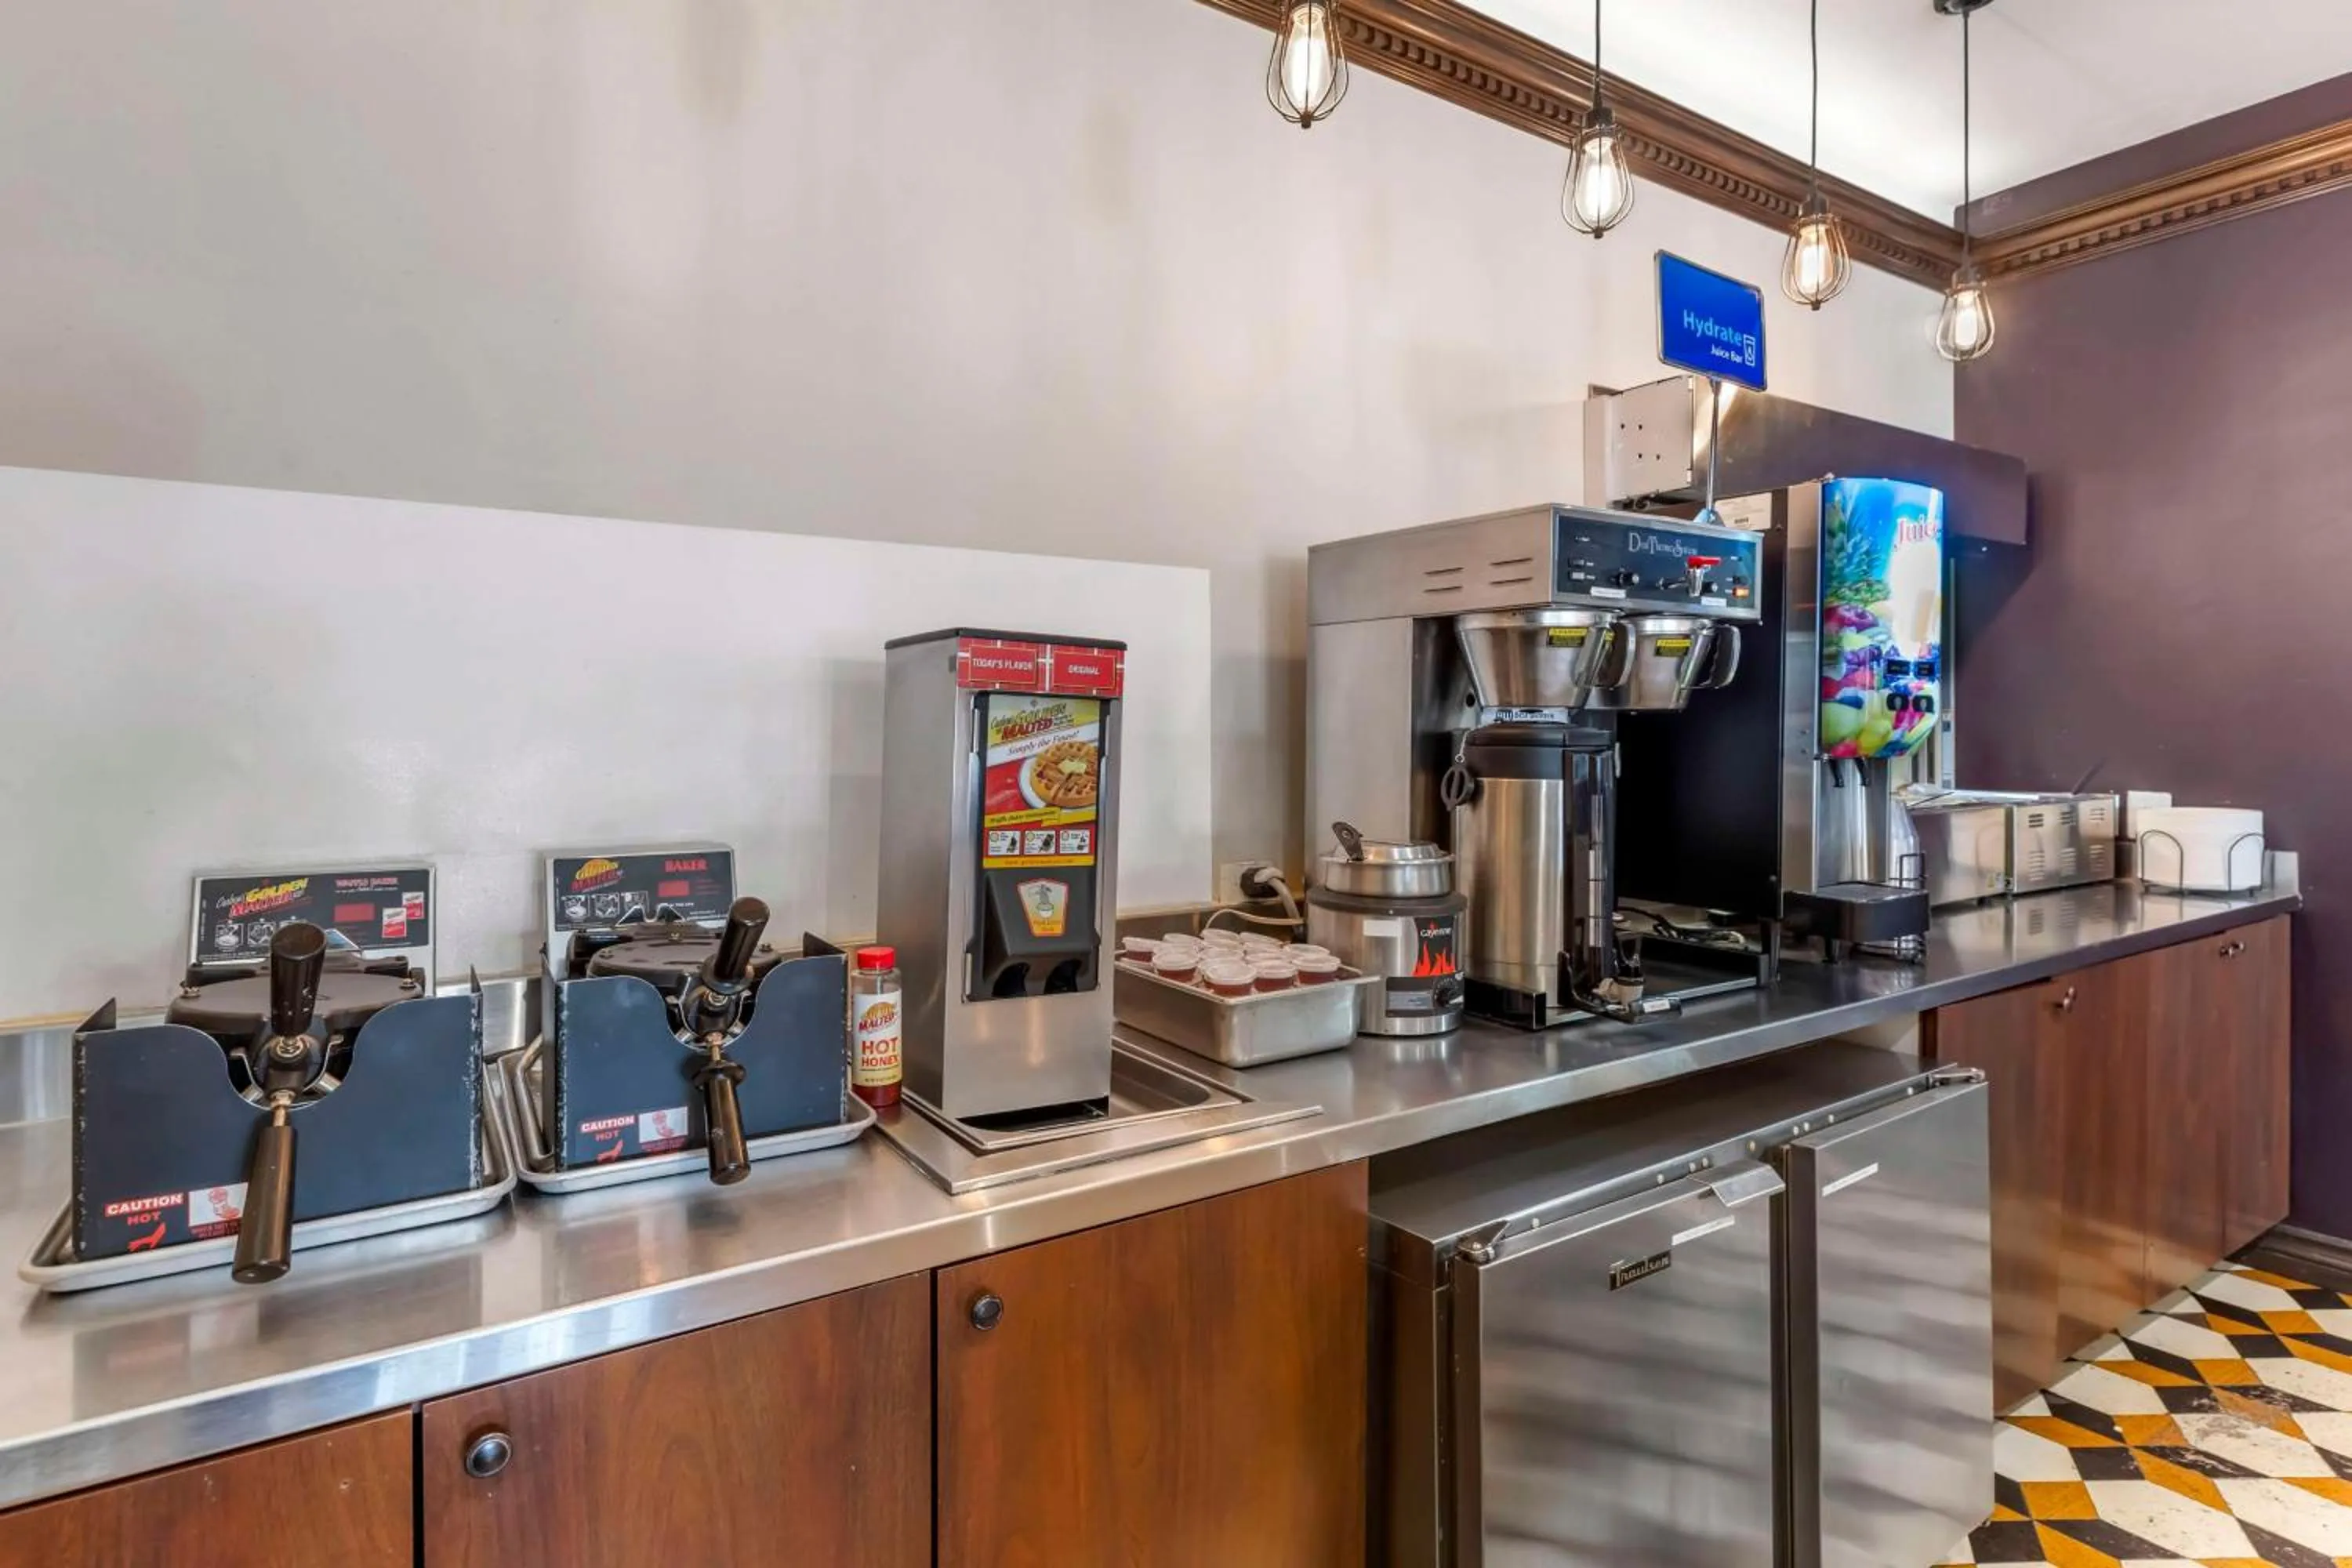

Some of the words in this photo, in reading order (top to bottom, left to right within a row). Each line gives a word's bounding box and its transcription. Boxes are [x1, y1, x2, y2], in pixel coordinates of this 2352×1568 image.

[1683, 309, 1743, 347] Hydrate
[1711, 343, 1730, 360] Juice
[1730, 350, 1744, 364] Bar
[972, 657, 1003, 668] TODAY'S
[1004, 659, 1033, 670] FLAVOR
[665, 858, 707, 872] BAKER
[858, 1013, 895, 1032] MALTED
[862, 1036, 898, 1055] HOT
[862, 1056, 898, 1067] HONEY
[581, 1115, 635, 1133] CAUTION
[594, 1130, 621, 1142] HOT
[106, 1193, 184, 1215] CAUTION
[127, 1211, 162, 1225] HOT
